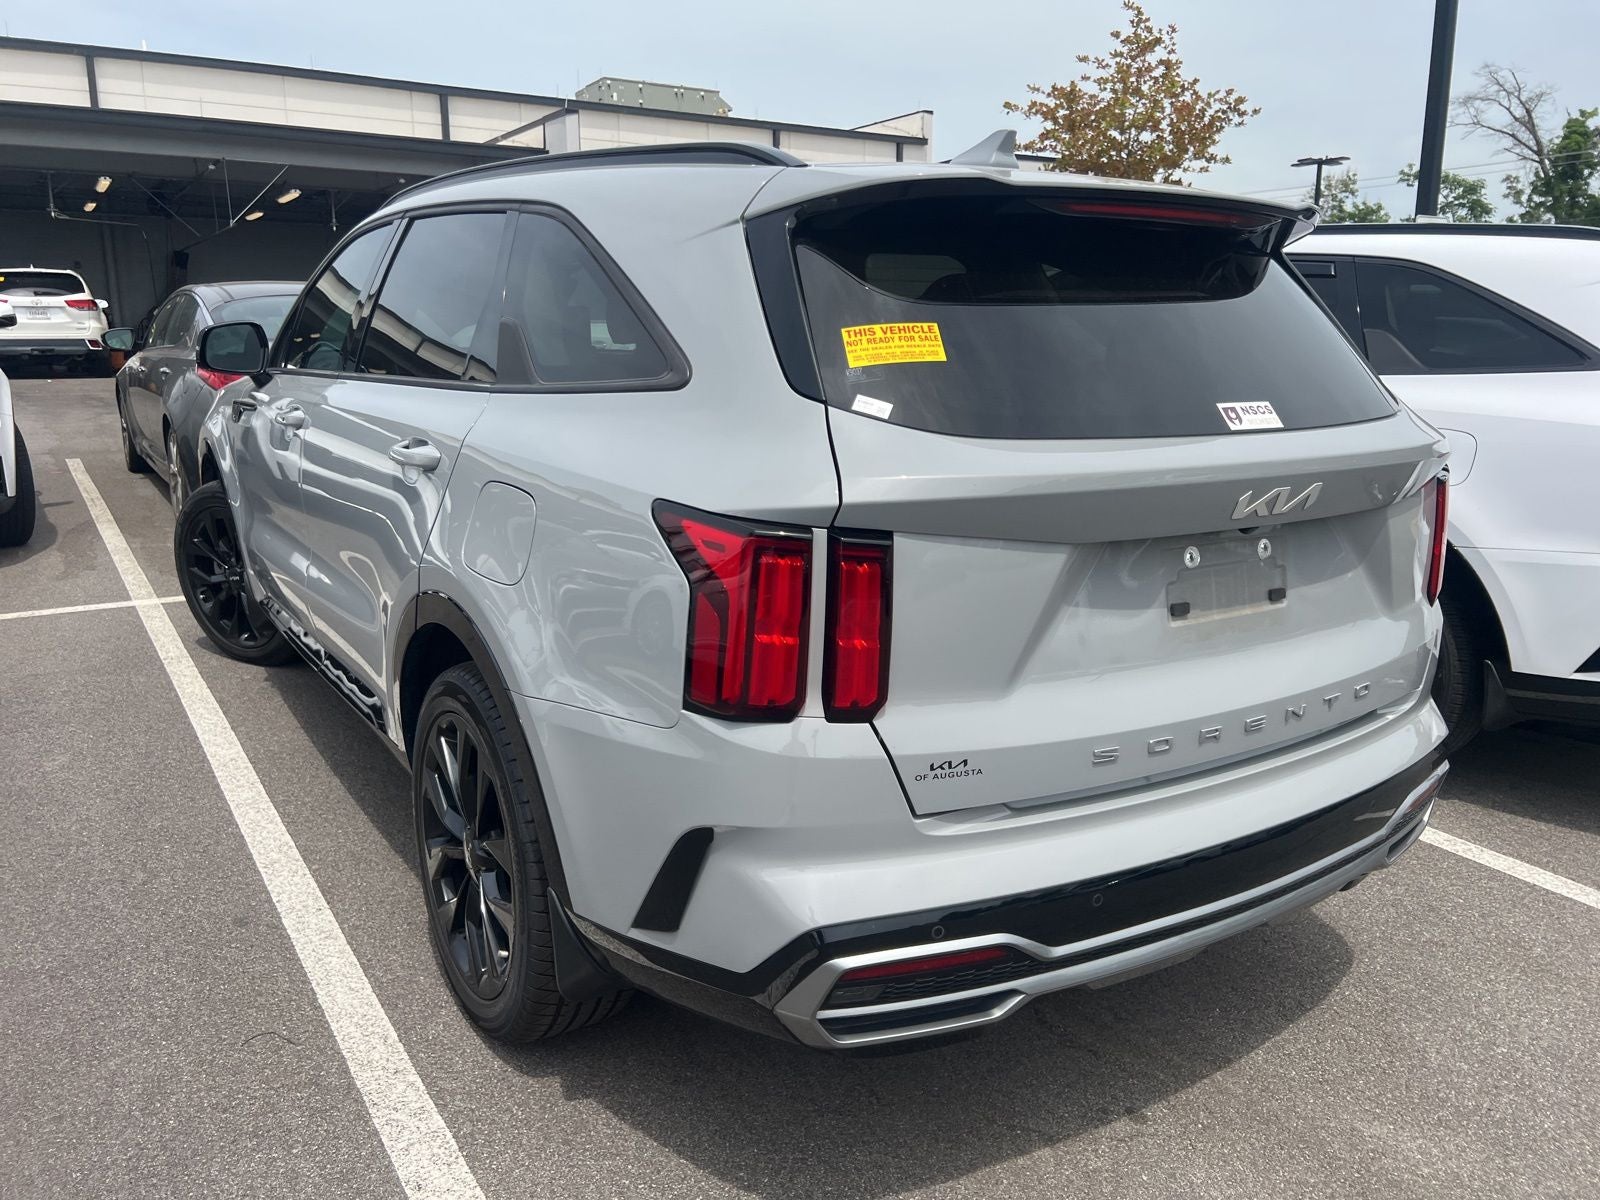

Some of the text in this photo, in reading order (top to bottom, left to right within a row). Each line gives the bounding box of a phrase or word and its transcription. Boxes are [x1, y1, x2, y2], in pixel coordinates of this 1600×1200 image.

[845, 324, 937, 339] THIS VEHICLE
[846, 334, 940, 347] NOT READY FOR SALE
[1240, 405, 1273, 416] NSCS
[1231, 482, 1323, 520] KIA
[1091, 681, 1371, 763] SORENTO
[929, 758, 969, 772] KIA
[914, 768, 984, 782] OF AUGUSTA
